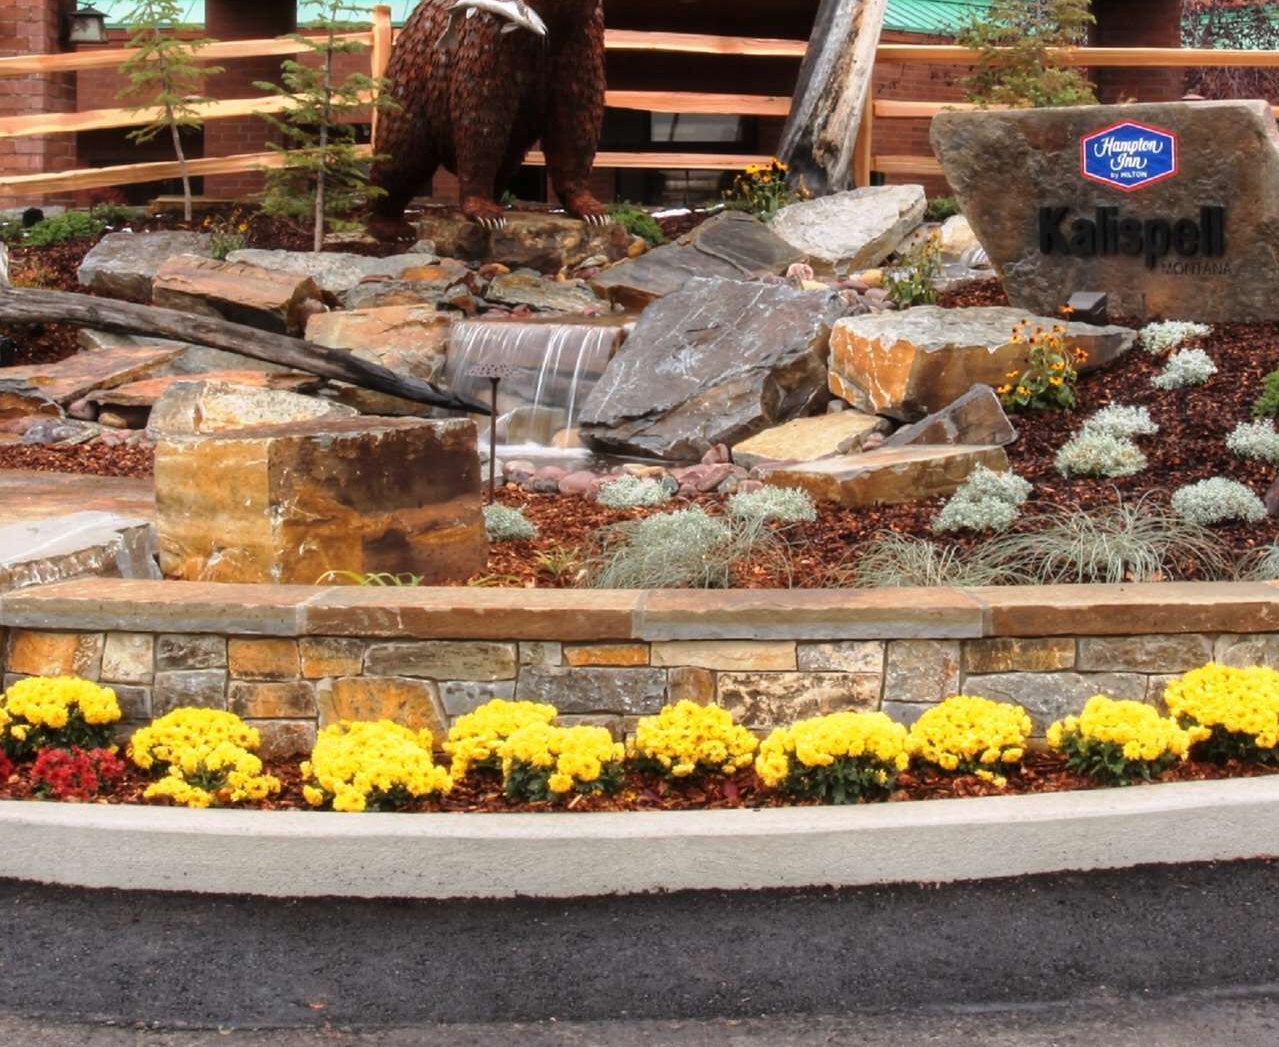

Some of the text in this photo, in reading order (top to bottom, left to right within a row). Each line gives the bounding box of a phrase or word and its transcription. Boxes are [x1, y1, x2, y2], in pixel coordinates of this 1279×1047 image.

[1094, 136, 1163, 158] Hampton
[1110, 152, 1148, 171] Inn
[1039, 206, 1227, 270] Kalispell
[1161, 261, 1233, 276] MONTANA
